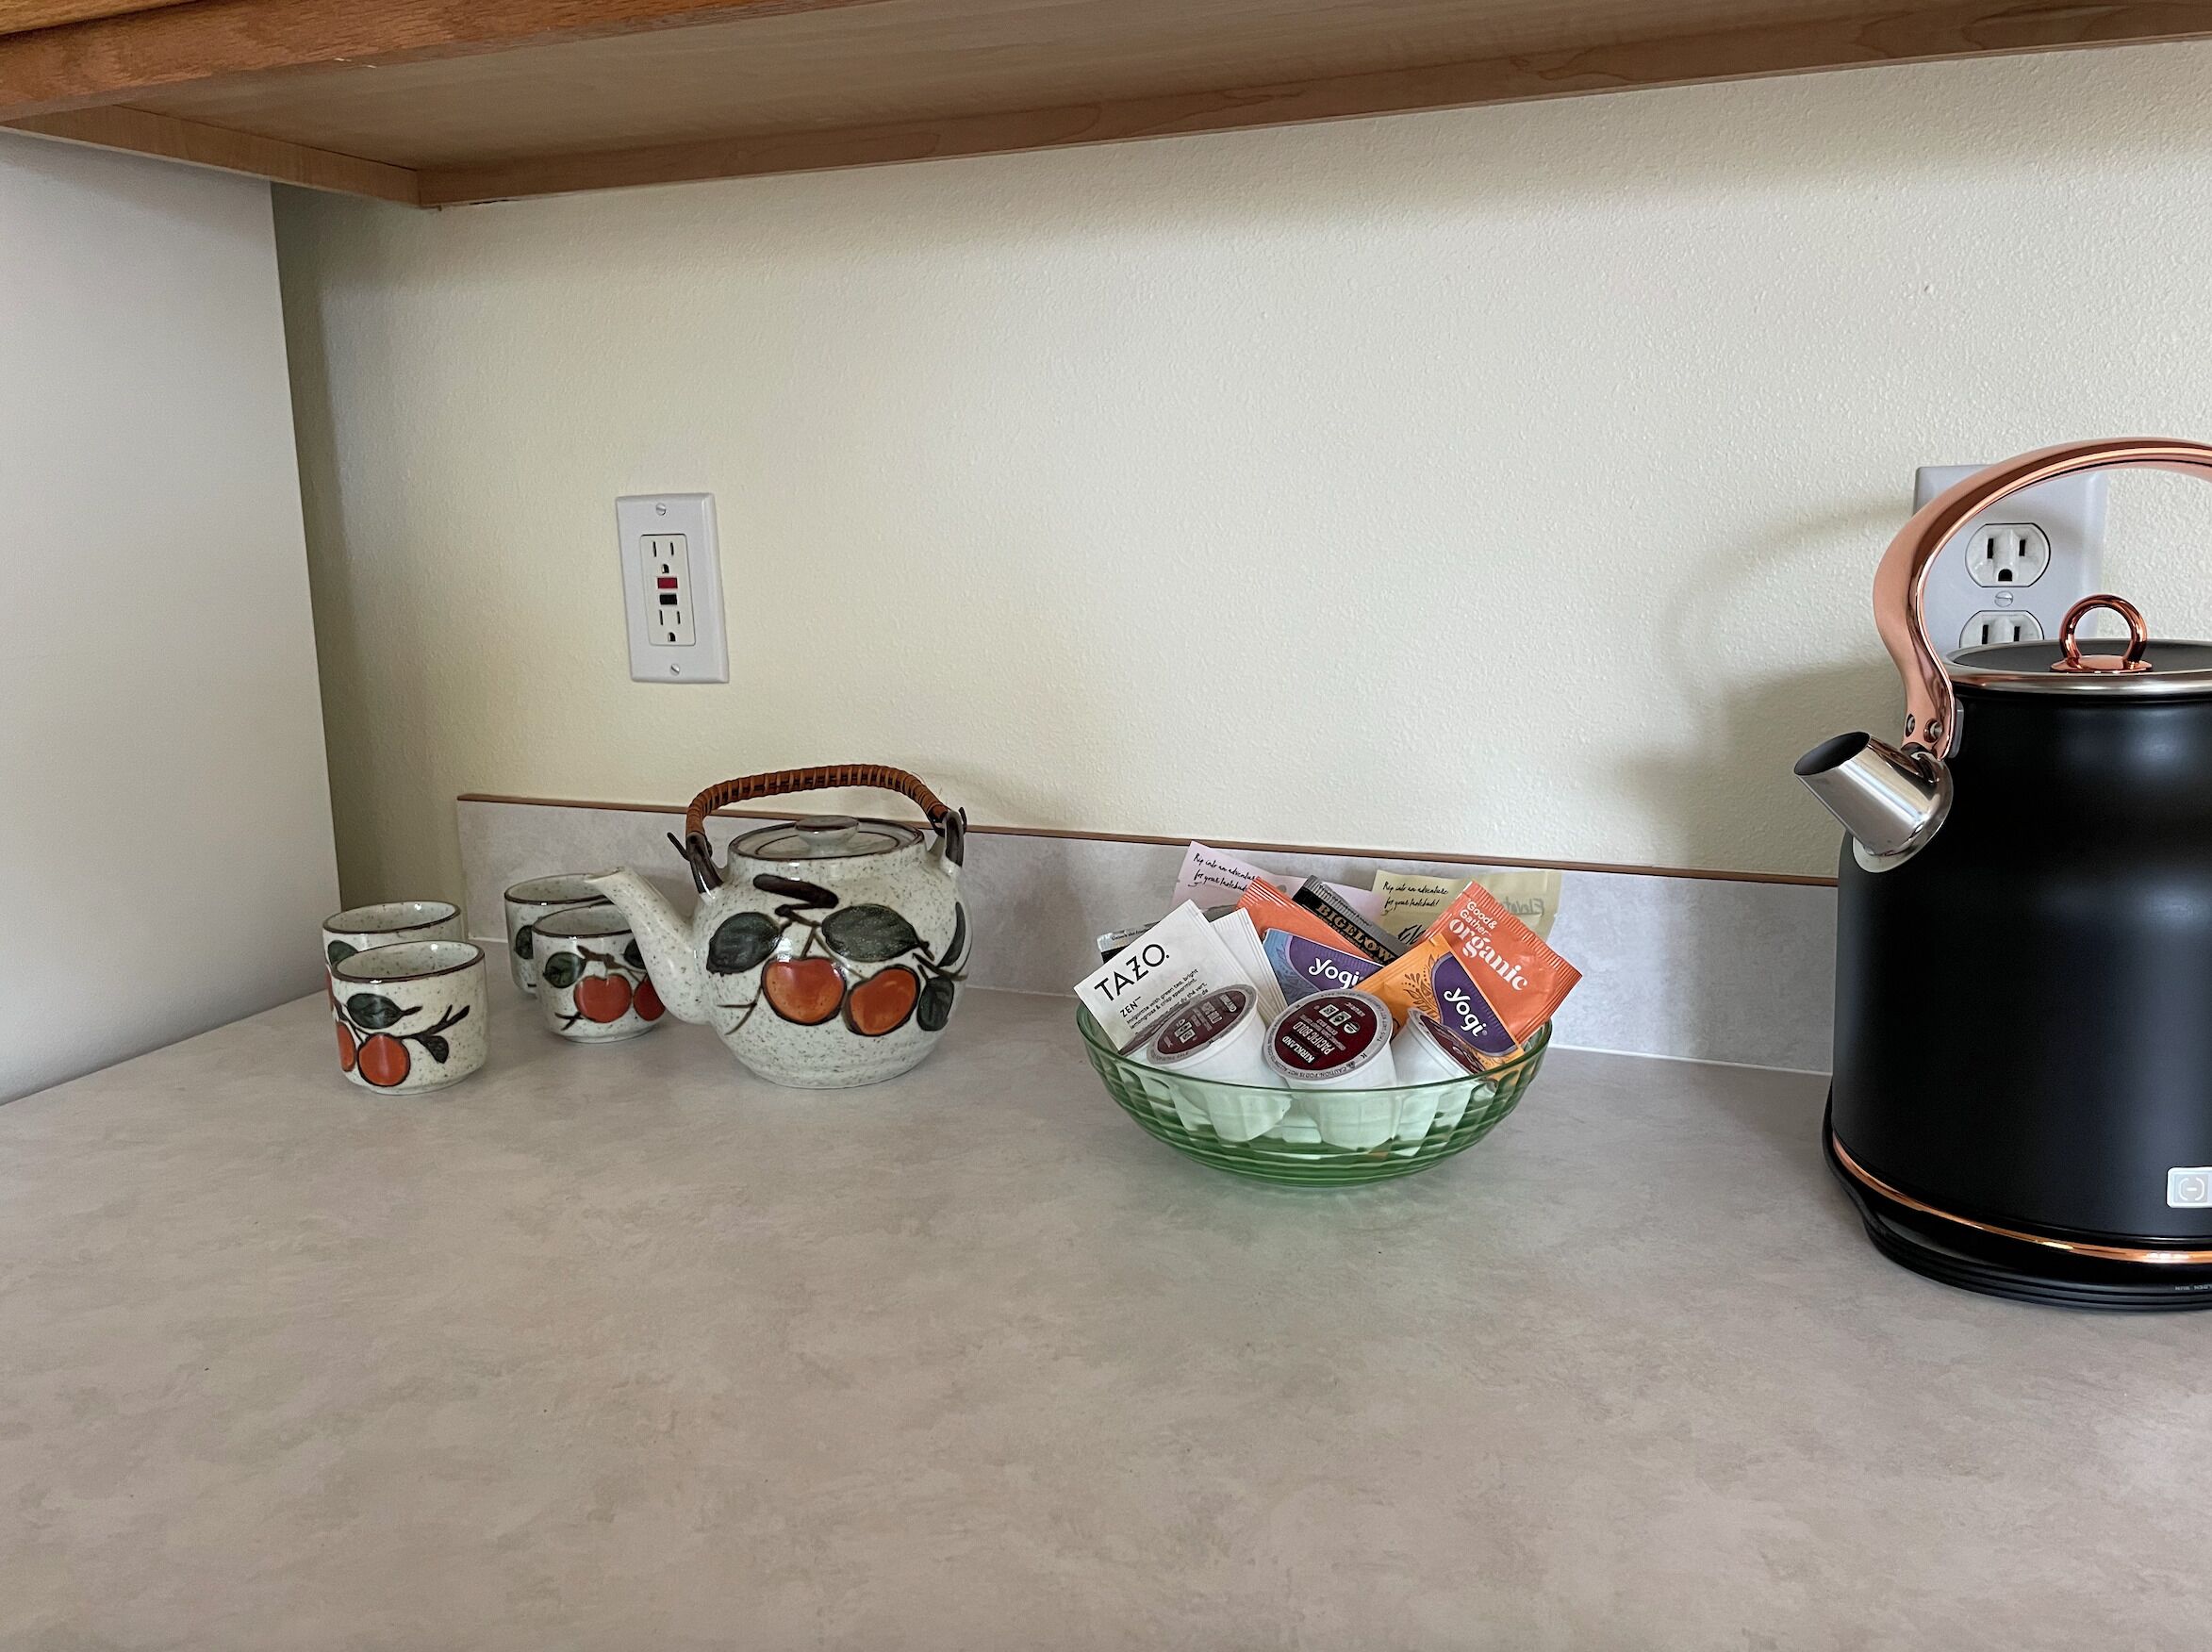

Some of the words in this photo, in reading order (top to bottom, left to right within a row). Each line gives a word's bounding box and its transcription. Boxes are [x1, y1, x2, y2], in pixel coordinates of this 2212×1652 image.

[1193, 852, 1204, 866] Rip
[1193, 868, 1204, 881] for
[1382, 881, 1395, 894] Rip
[1417, 884, 1449, 895] adventure
[1383, 896, 1395, 909] for
[1316, 903, 1396, 963] BIGELOW
[1460, 909, 1490, 936] Gather
[1449, 918, 1528, 991] organic
[1308, 957, 1361, 990] yogi
[1127, 1005, 1149, 1025] Invigorate
[1149, 997, 1161, 1007] with
[1160, 986, 1174, 1000] green
[1182, 968, 1199, 983] bright
[1131, 1009, 1156, 1030] lemongrass
[1160, 996, 1173, 1007] crisp
[1443, 987, 1488, 1037] yogi
[1292, 1021, 1312, 1038] BOLD
[1309, 1029, 1336, 1055] PACIFIC
[1281, 1035, 1316, 1064] KIRKLAND
